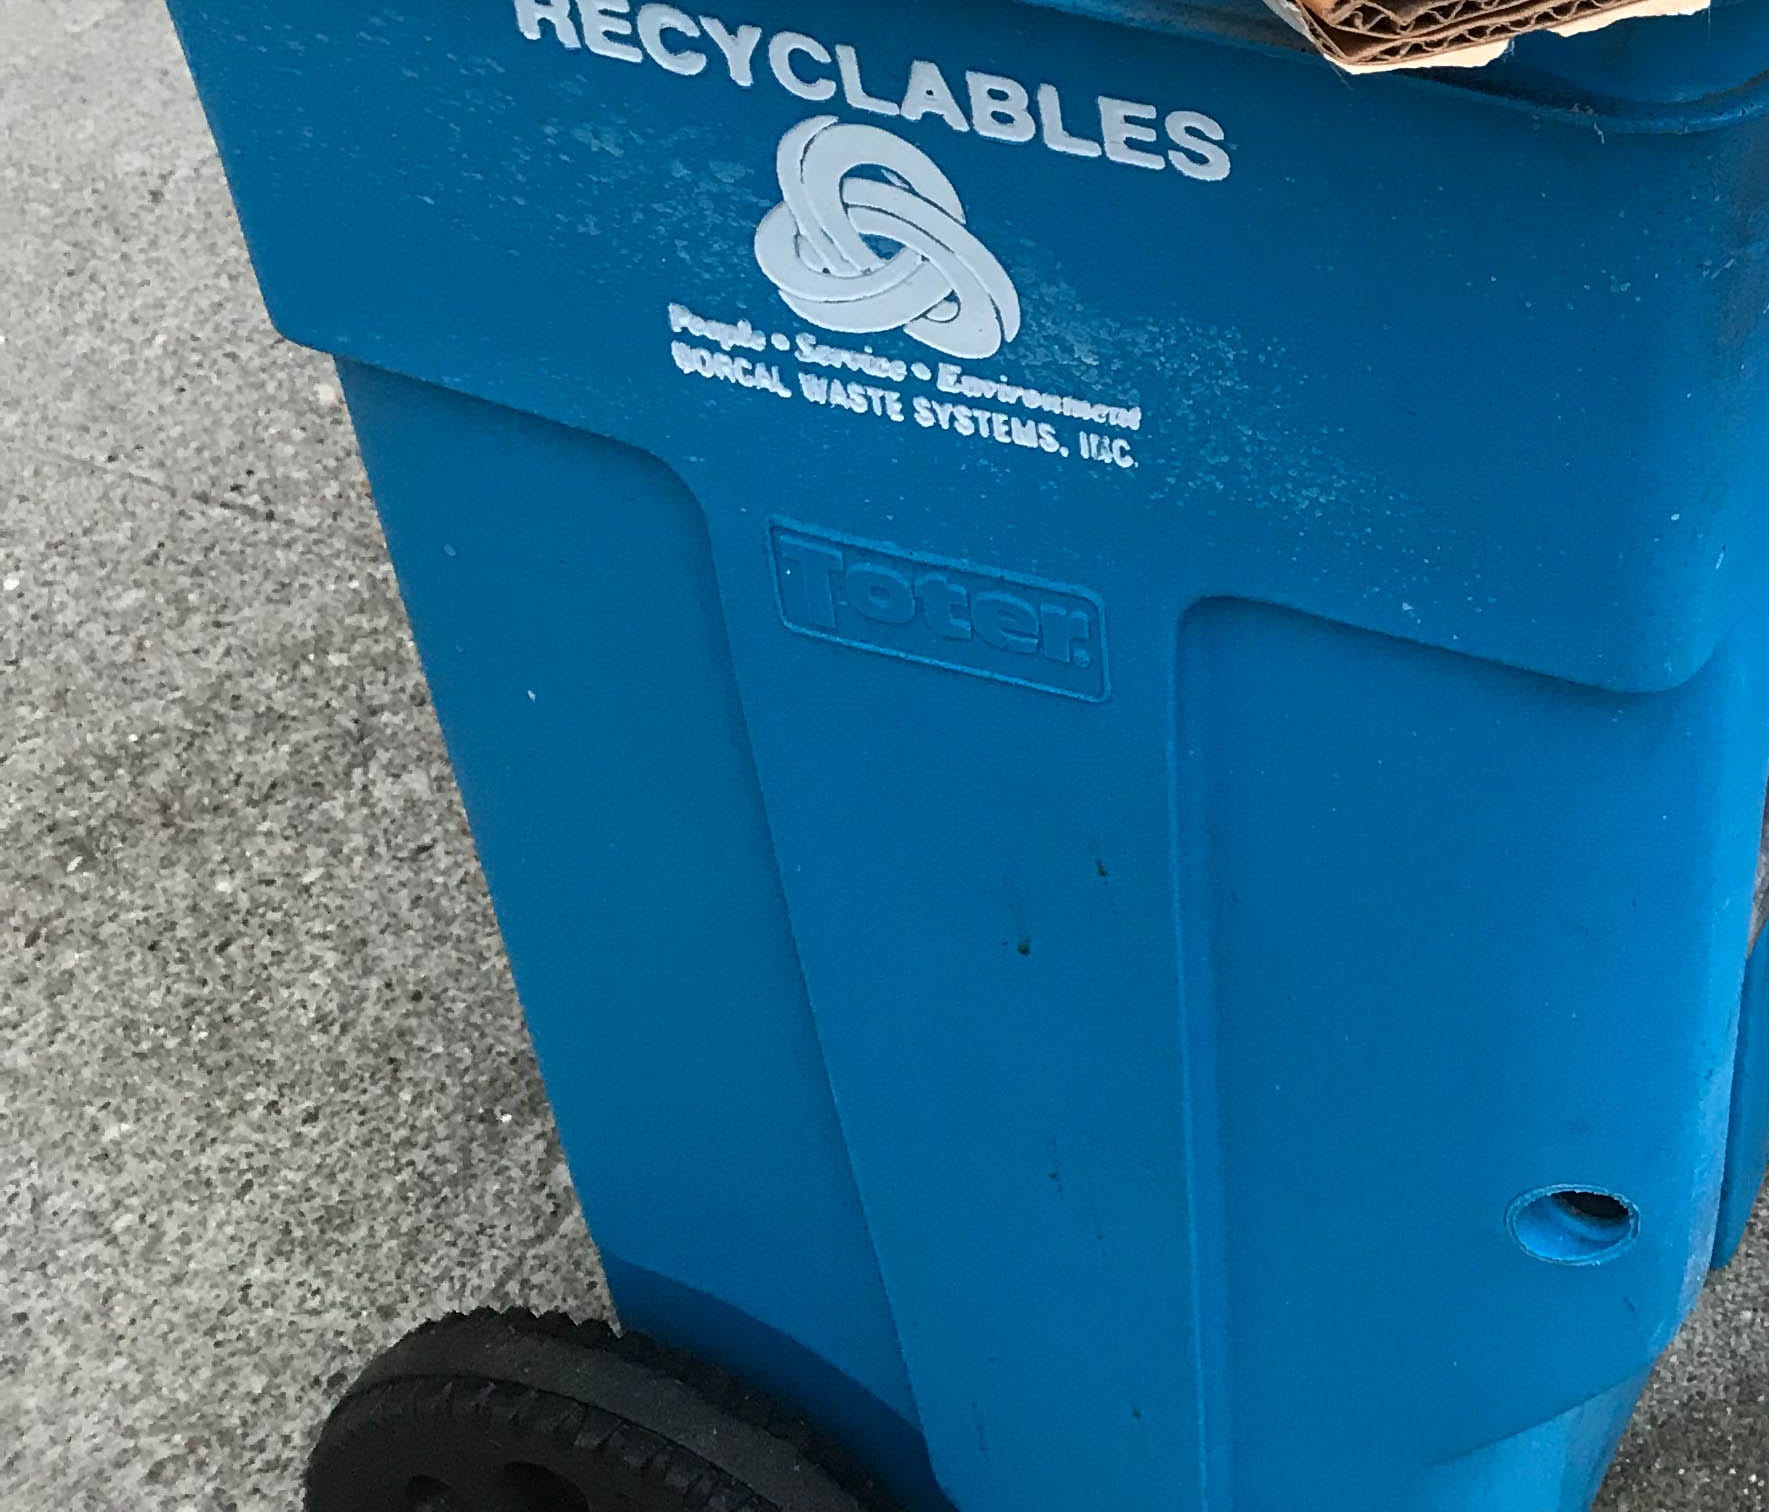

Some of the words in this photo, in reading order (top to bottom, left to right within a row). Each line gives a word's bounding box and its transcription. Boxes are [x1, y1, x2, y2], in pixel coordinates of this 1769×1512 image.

[668, 302, 767, 351] People
[796, 332, 907, 382] Service
[798, 371, 905, 422] WASTE
